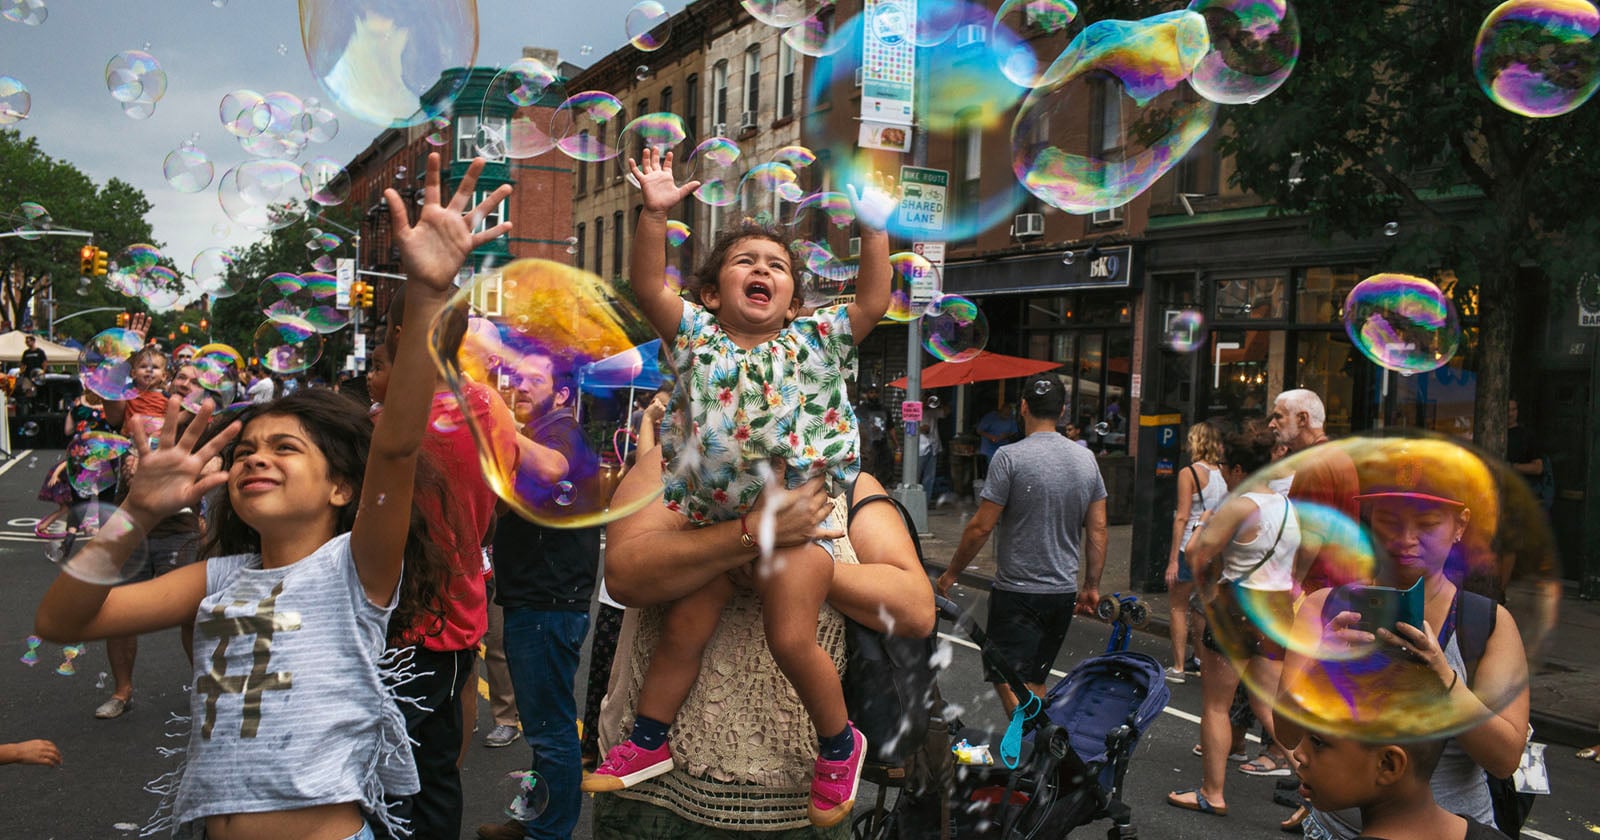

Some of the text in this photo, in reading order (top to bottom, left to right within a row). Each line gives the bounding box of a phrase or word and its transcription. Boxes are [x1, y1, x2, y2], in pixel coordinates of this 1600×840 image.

[904, 170, 945, 184] BIKE ROUTE
[901, 199, 943, 213] SHARED
[906, 211, 935, 224] LANE
[1090, 255, 1119, 280] BK9
[1163, 428, 1173, 444] P
